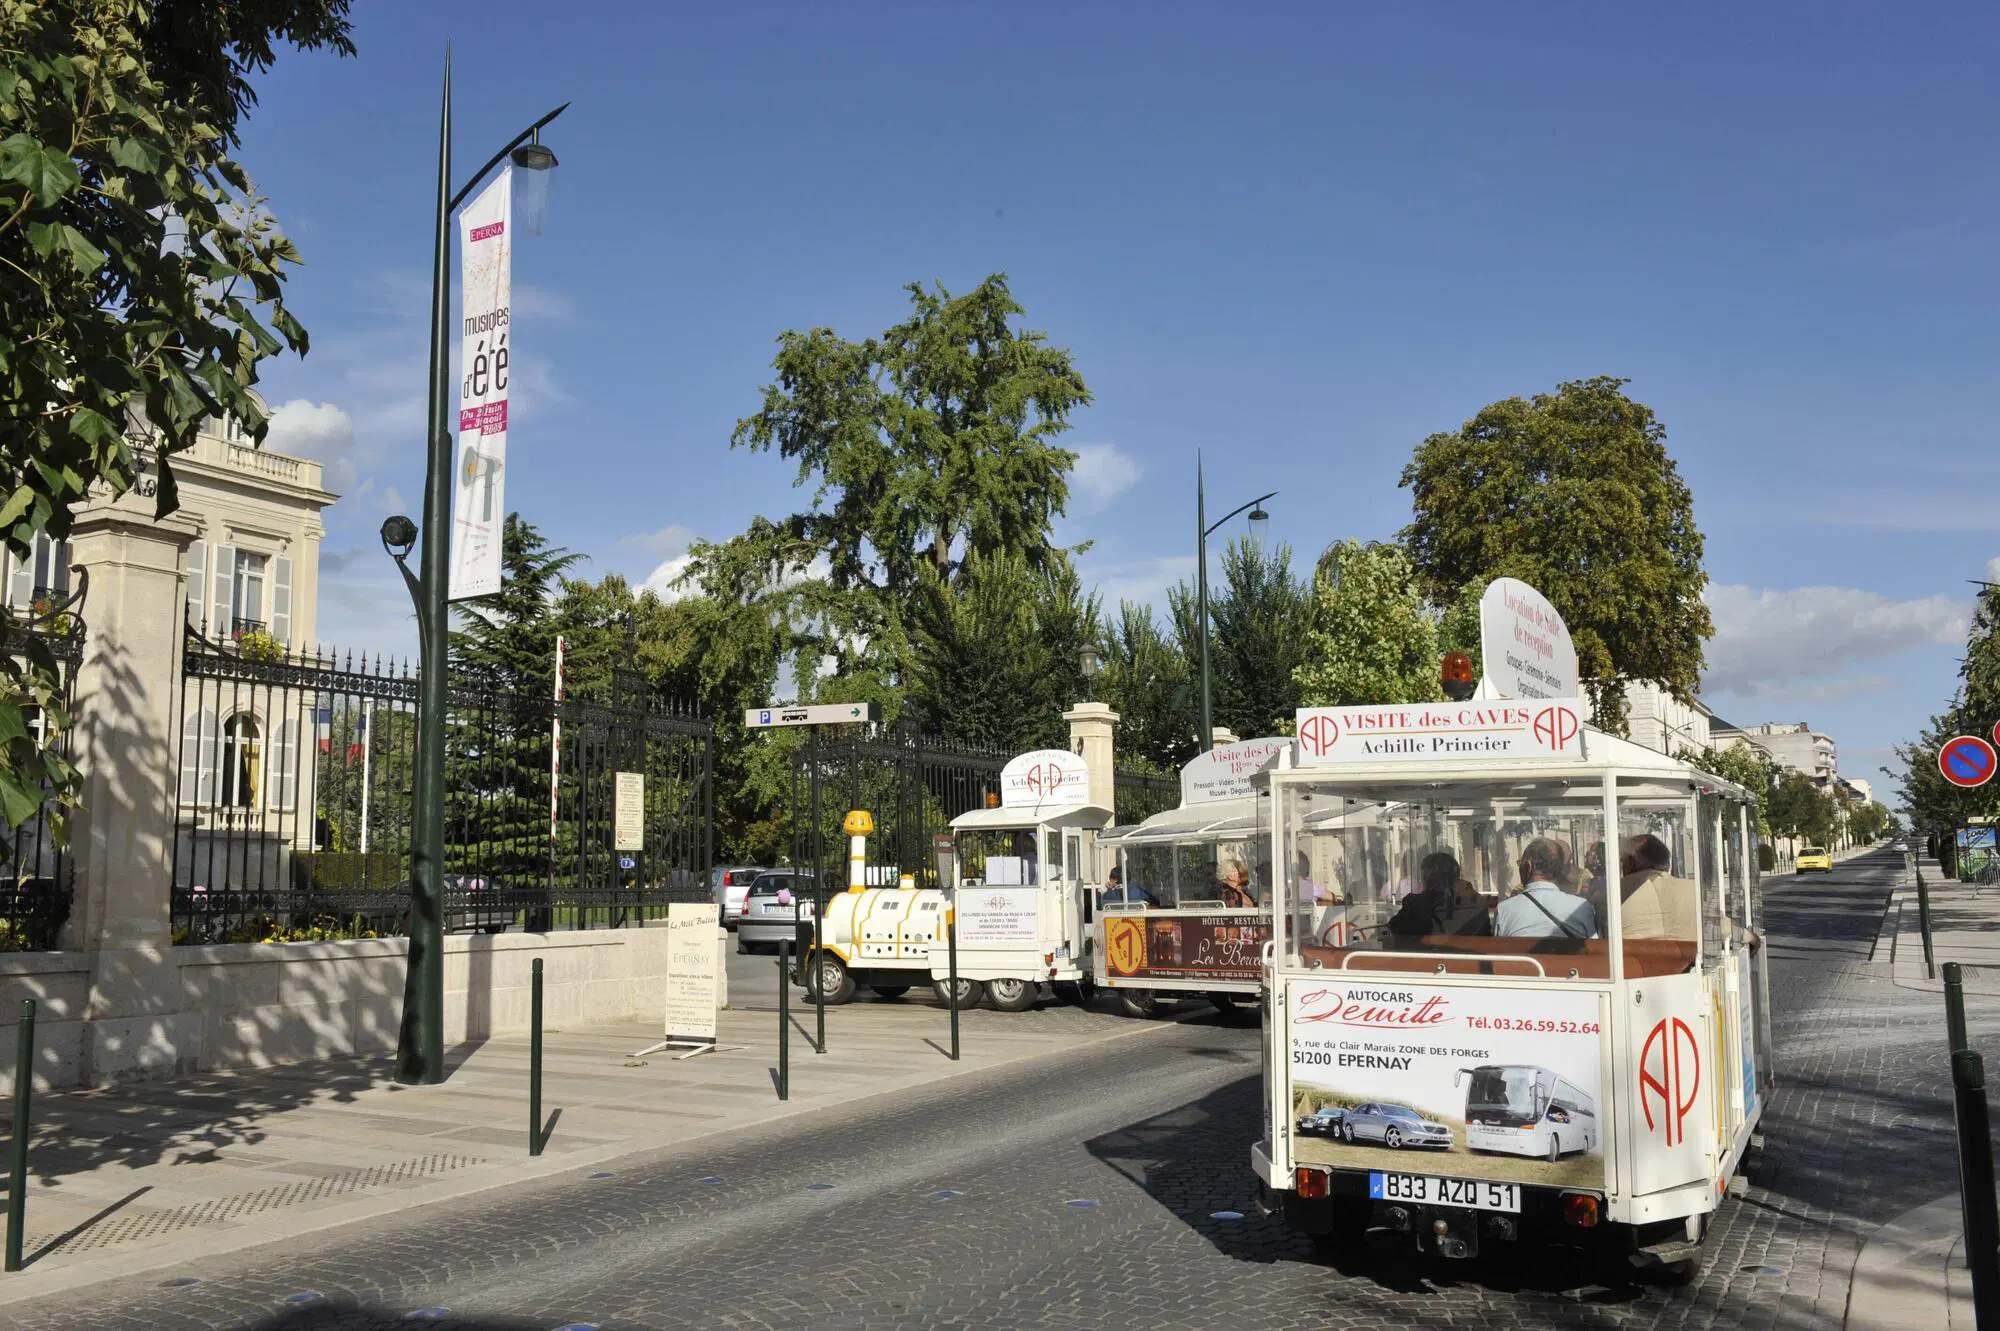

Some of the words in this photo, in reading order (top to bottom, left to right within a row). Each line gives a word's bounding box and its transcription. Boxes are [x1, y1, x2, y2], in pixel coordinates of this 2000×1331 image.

[471, 224, 503, 241] EPERNA
[465, 307, 509, 337] musiqes
[462, 410, 474, 420] Du
[484, 404, 503, 416] juin
[1343, 711, 1412, 730] VISITE
[1419, 708, 1452, 728] des
[1458, 707, 1530, 726] CAVES
[1211, 749, 1241, 763] Visite
[1244, 746, 1262, 759] des
[1265, 743, 1282, 756] Ca
[1361, 739, 1425, 755] Achille
[1432, 735, 1511, 752] Princier
[1202, 916, 1224, 925] HÔTEL
[1192, 938, 1214, 965] Les
[1219, 937, 1261, 966] Berce
[1347, 990, 1414, 1004] AUTOCARS
[1466, 1016, 1491, 1029] Tél.
[1494, 1018, 1600, 1035] 03.26.59.52.64
[1293, 1038, 1301, 1048] 9,
[1324, 1040, 1335, 1049] du
[1340, 1041, 1360, 1050] Clair
[1364, 1043, 1396, 1053] Marais
[1399, 1045, 1426, 1055] ZONE
[1430, 1047, 1447, 1056] DES
[1451, 1048, 1489, 1058] FORGES
[1293, 1051, 1331, 1065] 51200
[1339, 1053, 1412, 1070] EPERNAY
[1387, 1173, 1426, 1200] 833
[1438, 1178, 1477, 1205] AZQ
[1488, 1183, 1514, 1209] 51
